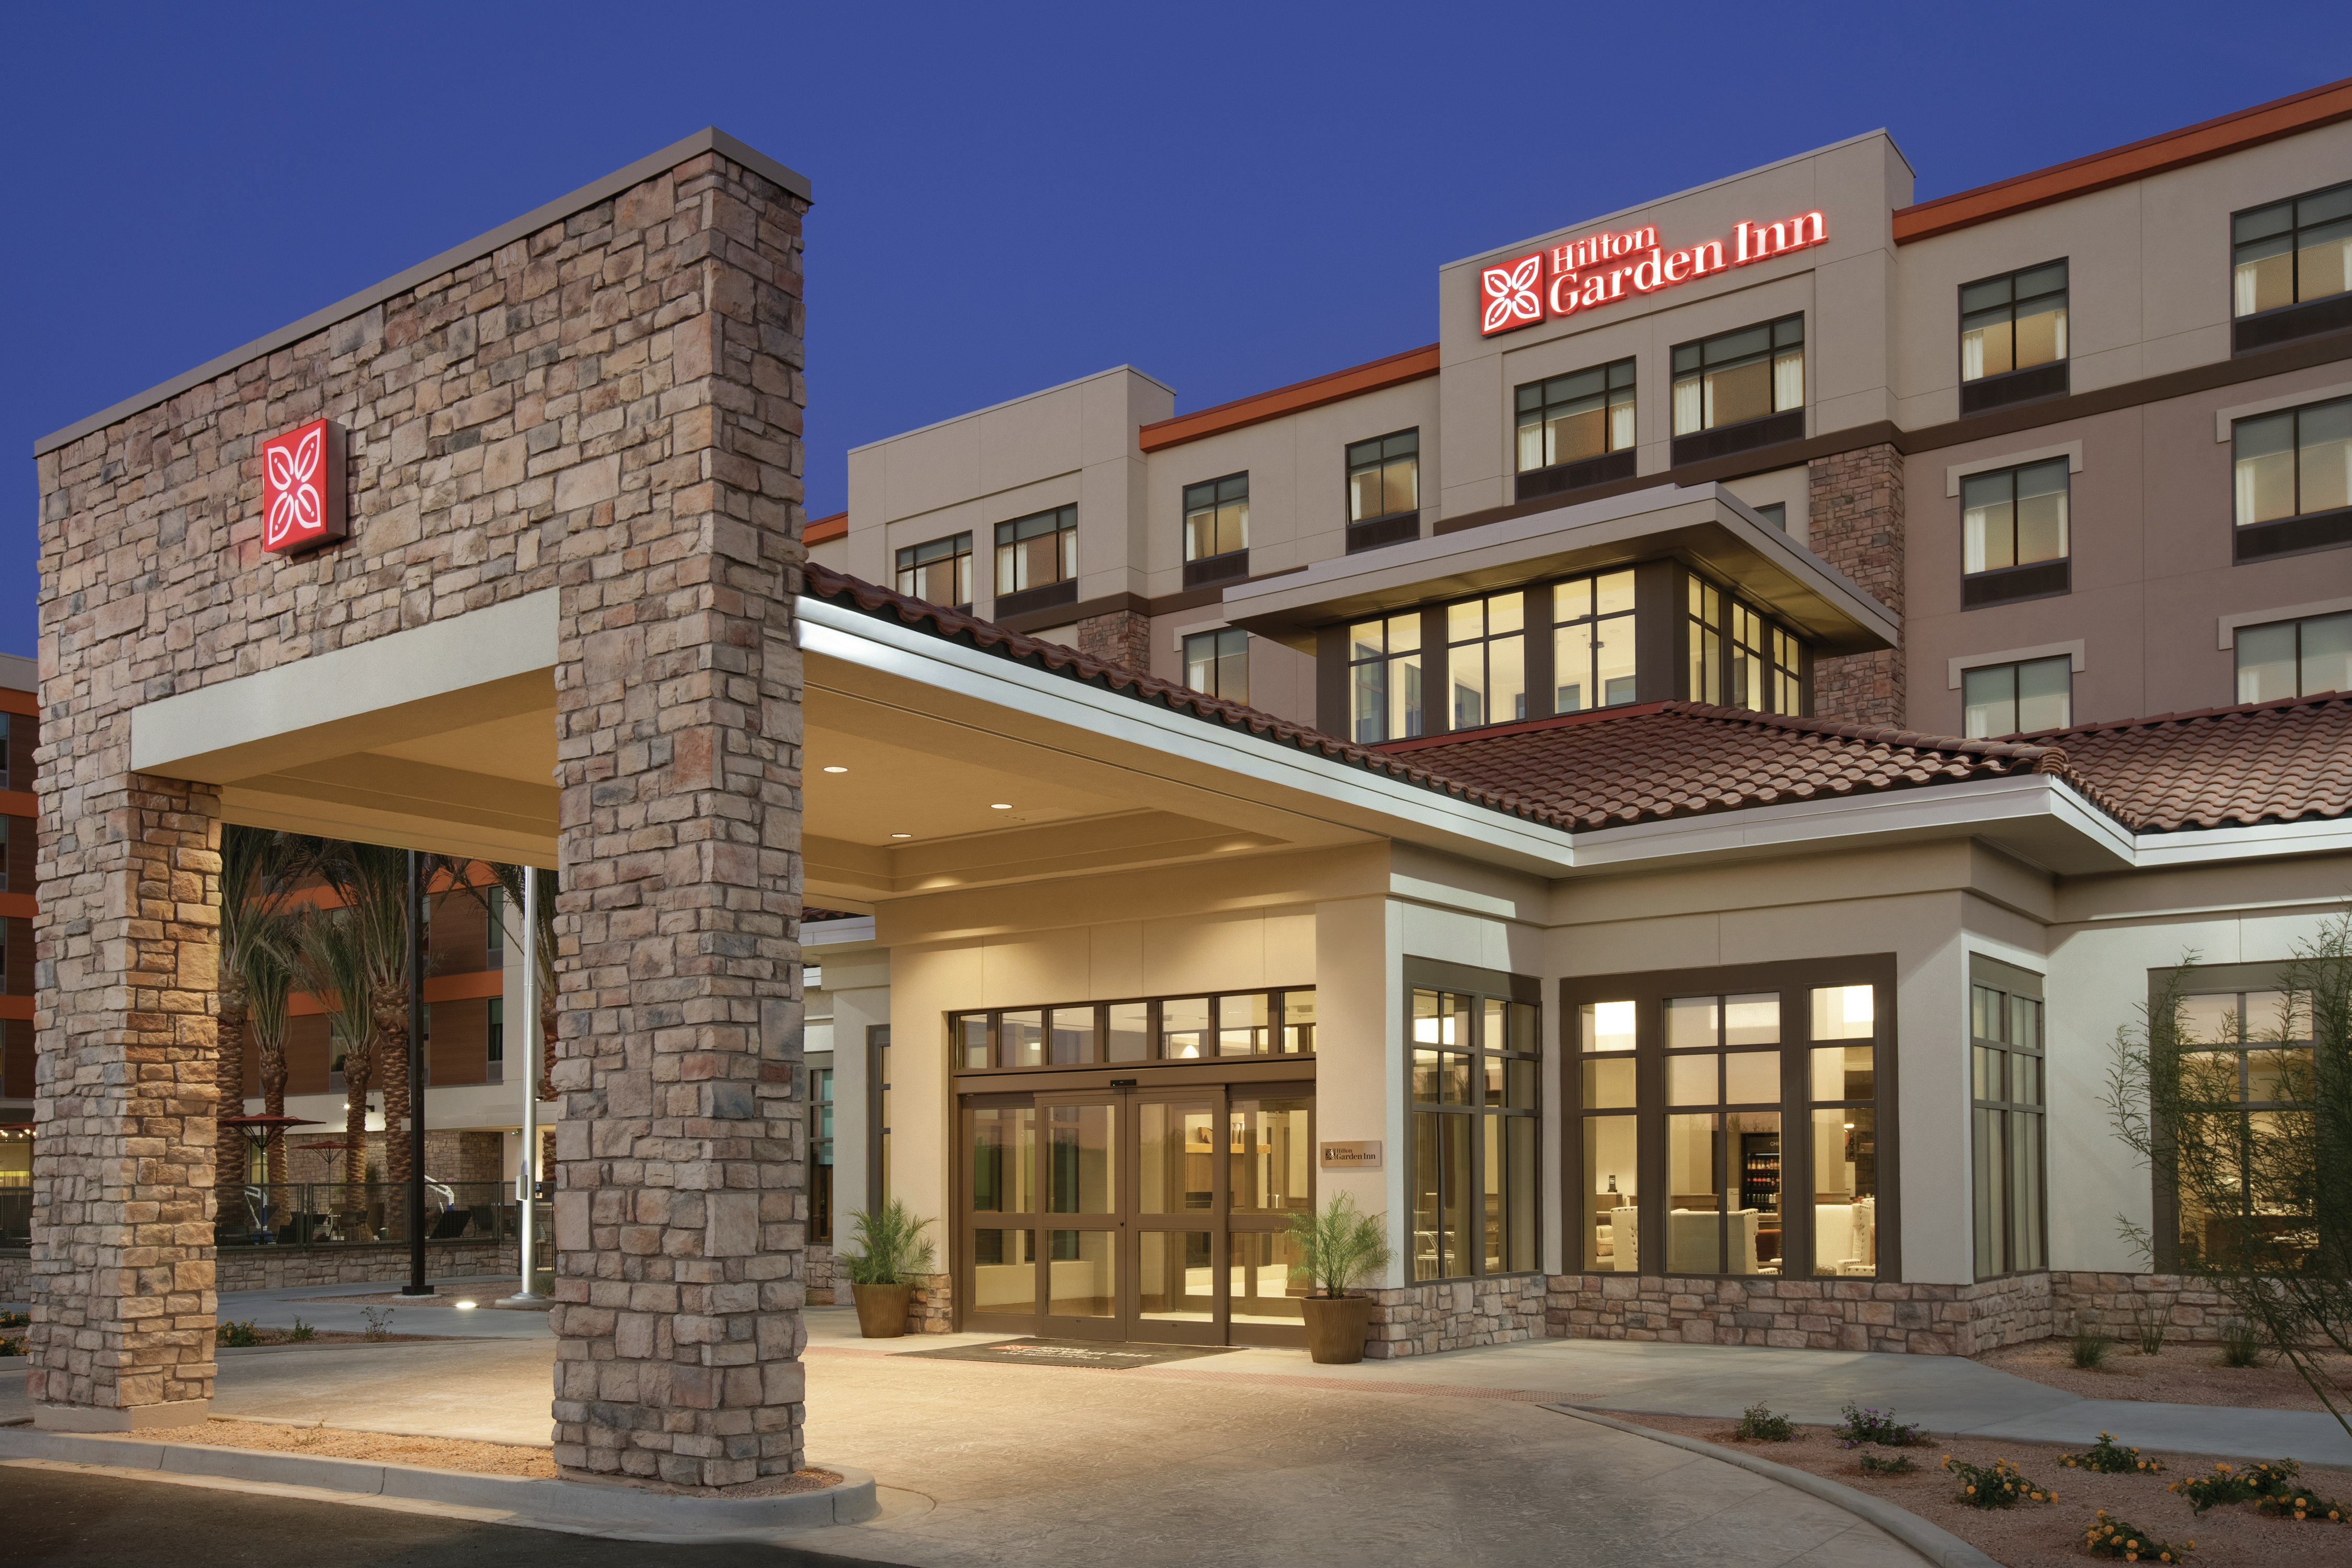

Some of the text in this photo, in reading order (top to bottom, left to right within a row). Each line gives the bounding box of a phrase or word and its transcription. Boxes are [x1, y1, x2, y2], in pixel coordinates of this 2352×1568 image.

[1548, 210, 1829, 315] Garden Inn
[1551, 225, 1658, 275] Hilton
